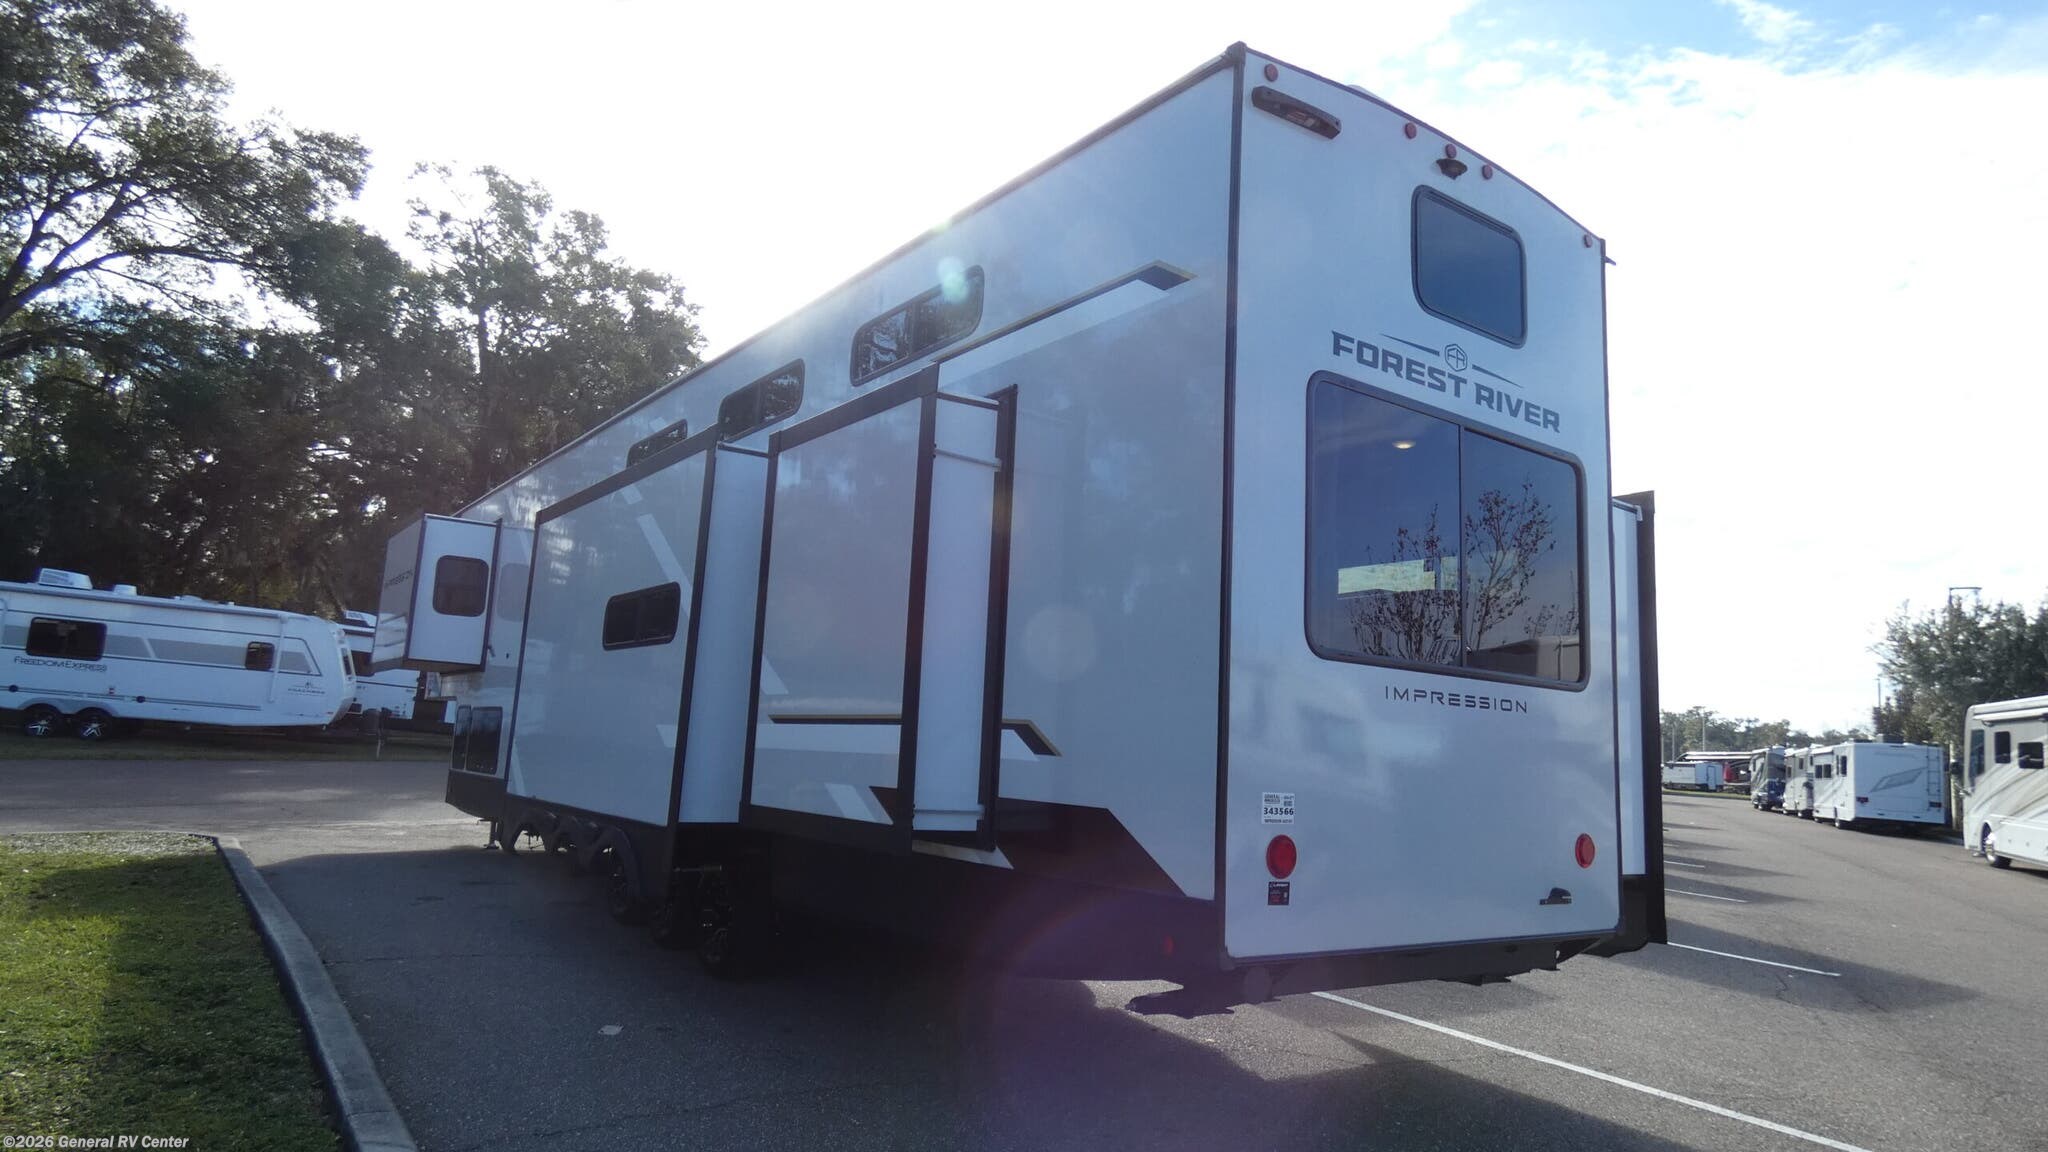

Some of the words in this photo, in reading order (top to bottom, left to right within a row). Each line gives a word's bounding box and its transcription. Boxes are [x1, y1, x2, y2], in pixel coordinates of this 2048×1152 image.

[1331, 330, 1467, 398] FOREST
[1474, 382, 1560, 433] RIVER
[1385, 685, 1528, 714] IMPRESSION
[1263, 807, 1294, 816] 343566
